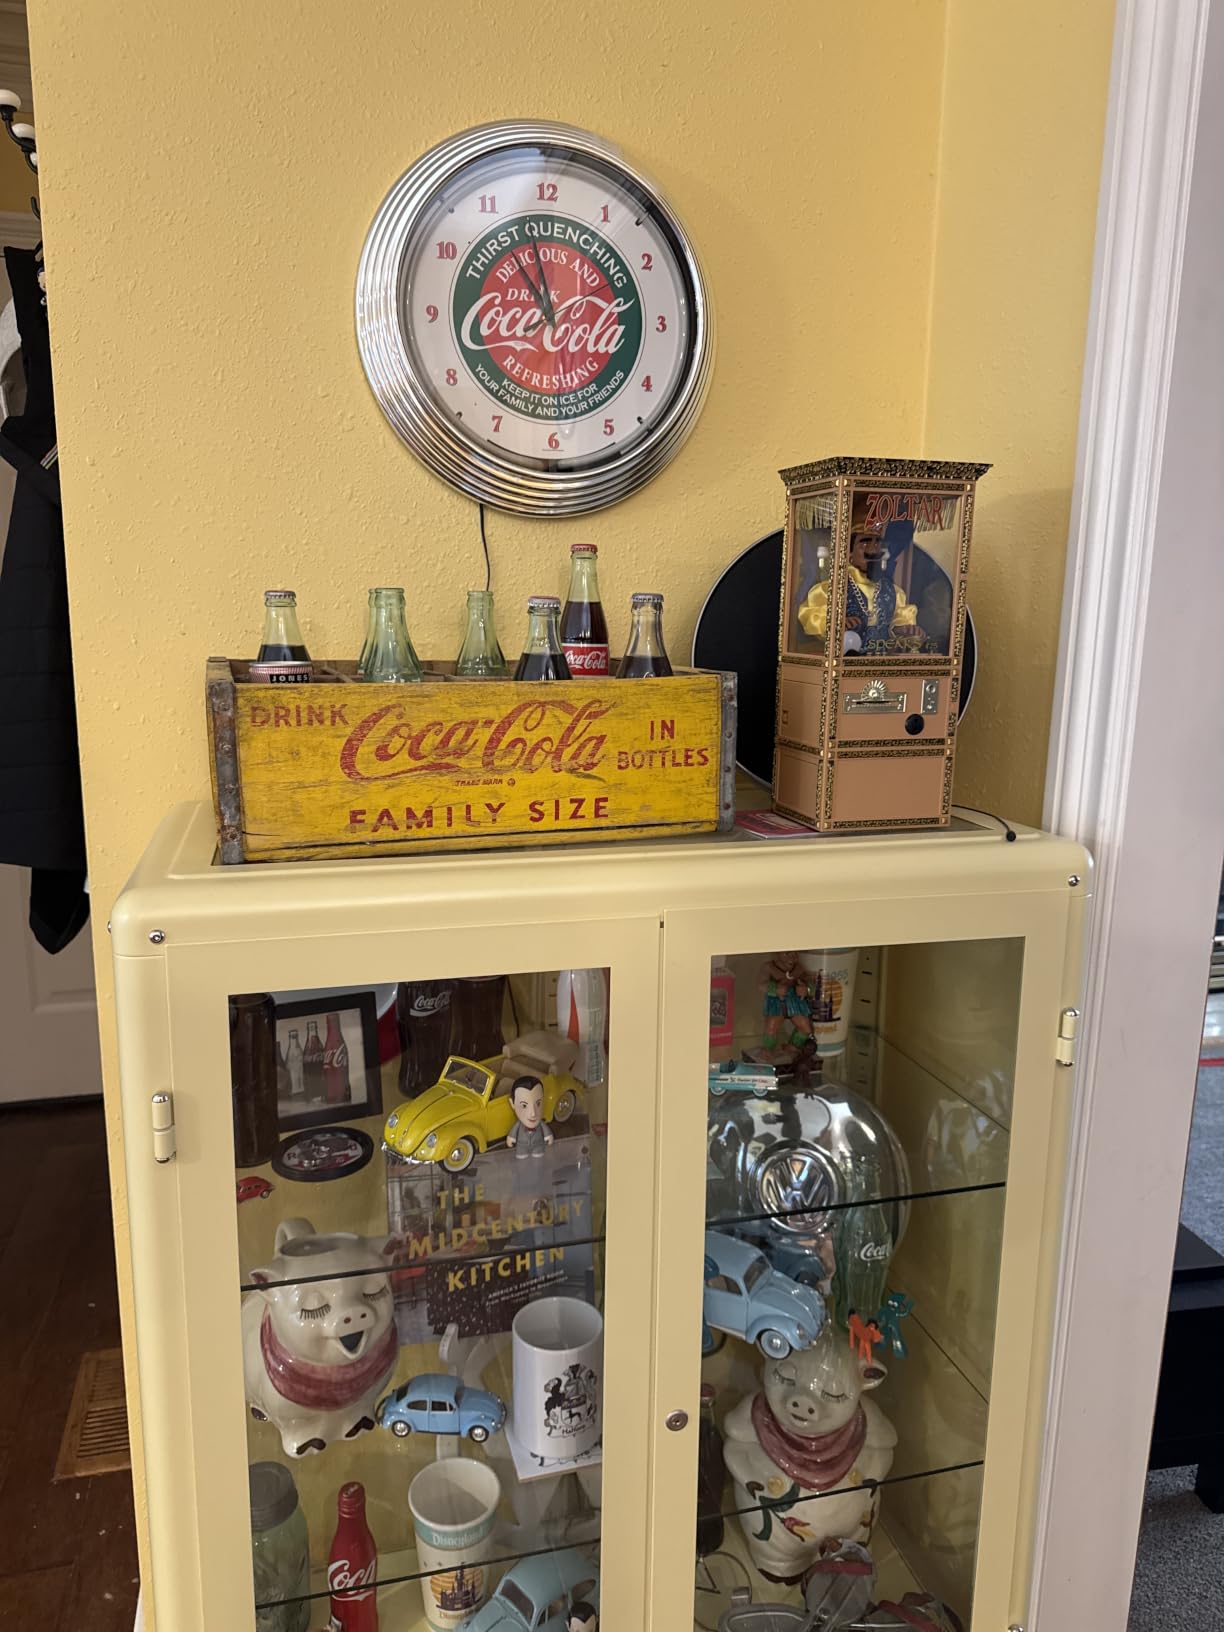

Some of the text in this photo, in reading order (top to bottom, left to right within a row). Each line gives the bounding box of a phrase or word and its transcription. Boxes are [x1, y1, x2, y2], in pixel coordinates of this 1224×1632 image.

[535, 183, 559, 202] 12
[478, 194, 499, 214] 11
[600, 205, 611, 222] 1
[436, 241, 458, 260] 10
[466, 222, 627, 289] THIRST QUENCHING
[641, 253, 653, 271] 2
[569, 258, 600, 287] AND
[425, 305, 439, 323] 9
[655, 313, 668, 332] 3
[445, 368, 458, 386] 8
[503, 357, 600, 389] REFRESHING
[475, 363, 626, 417] YOUR FAMILY AND YOUR FRIENDS
[502, 378, 599, 405] KEEP IT ON ICE FOR
[641, 375, 653, 392] 4
[491, 415, 504, 433] 7
[603, 418, 616, 436] 5
[547, 432, 560, 450] 6
[863, 494, 944, 531] ZOLTAR
[564, 650, 607, 670] Coca-Cola
[272, 674, 308, 682] JONES
[250, 702, 349, 728] DRINK
[650, 719, 675, 740] IN
[340, 699, 617, 781] Coca-Cola
[617, 747, 709, 770] BOTTLES
[350, 797, 609, 833] FAMILY SIZE
[437, 1183, 485, 1209] THE
[408, 1201, 584, 1260] MIDCENTURY
[448, 1247, 565, 1292] KITCHEN
